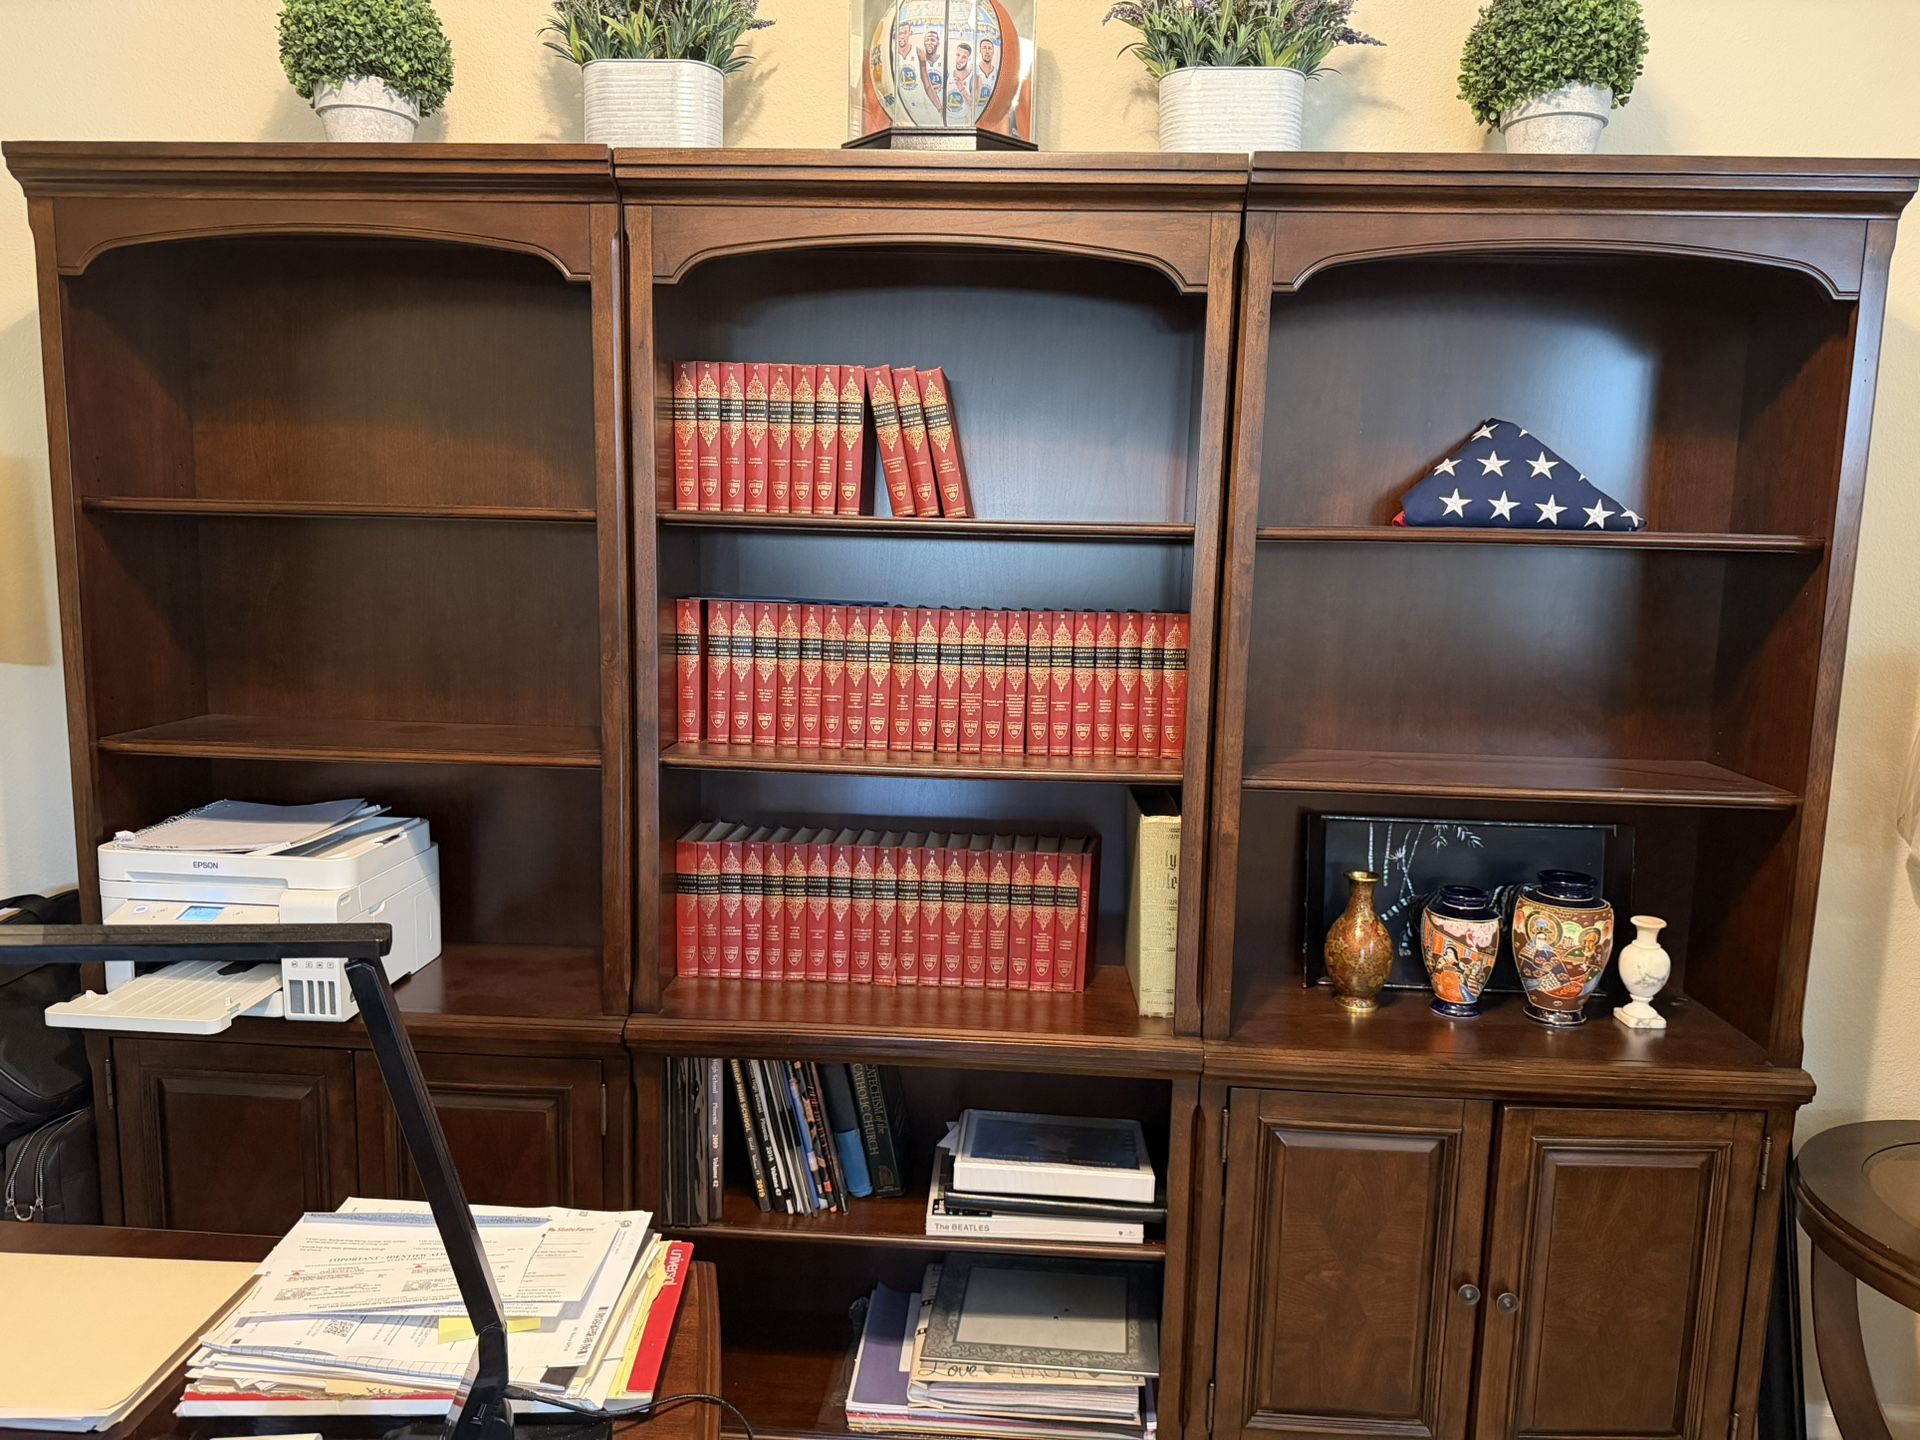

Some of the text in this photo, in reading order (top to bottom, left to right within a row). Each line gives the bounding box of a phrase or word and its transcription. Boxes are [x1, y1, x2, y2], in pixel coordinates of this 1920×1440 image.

[193, 861, 218, 869] EPSON
[853, 1063, 879, 1155] CATHOLIC CHURCH
[740, 1103, 751, 1132] SCHOOL
[756, 1179, 765, 1197] 2019
[712, 1156, 720, 1179] Volume
[770, 1166, 780, 1190] Volume
[935, 1223, 990, 1232] The BEATLES
